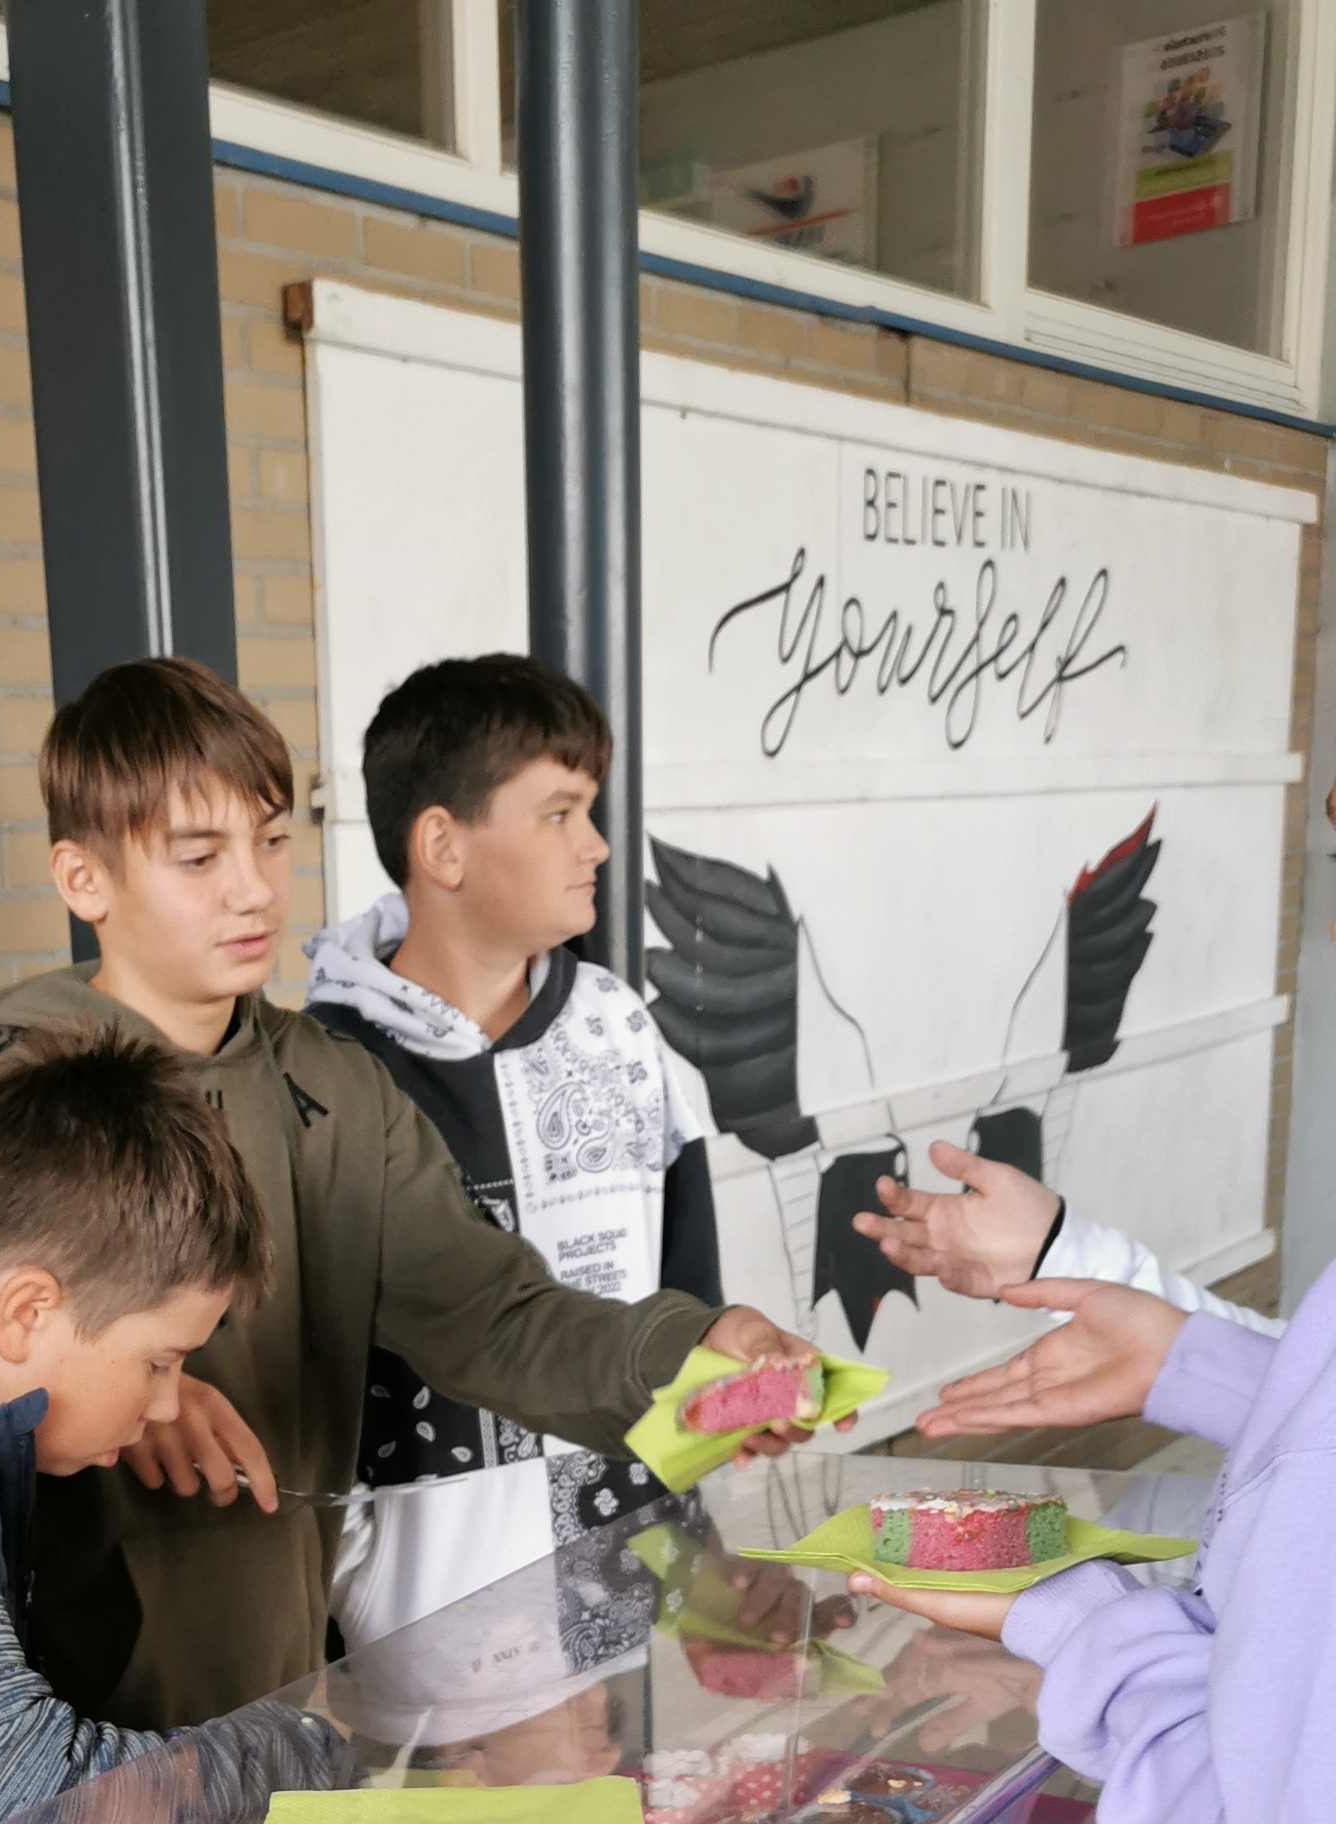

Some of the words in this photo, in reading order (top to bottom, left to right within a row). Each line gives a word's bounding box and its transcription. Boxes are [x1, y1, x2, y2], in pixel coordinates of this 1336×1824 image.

[863, 467, 988, 548] BELIEVE
[1000, 486, 1033, 552] IN
[557, 1233, 595, 1251] BLACK
[558, 1240, 617, 1262] PROJECTS
[560, 1263, 601, 1280] RAISED
[603, 1260, 614, 1271] IN
